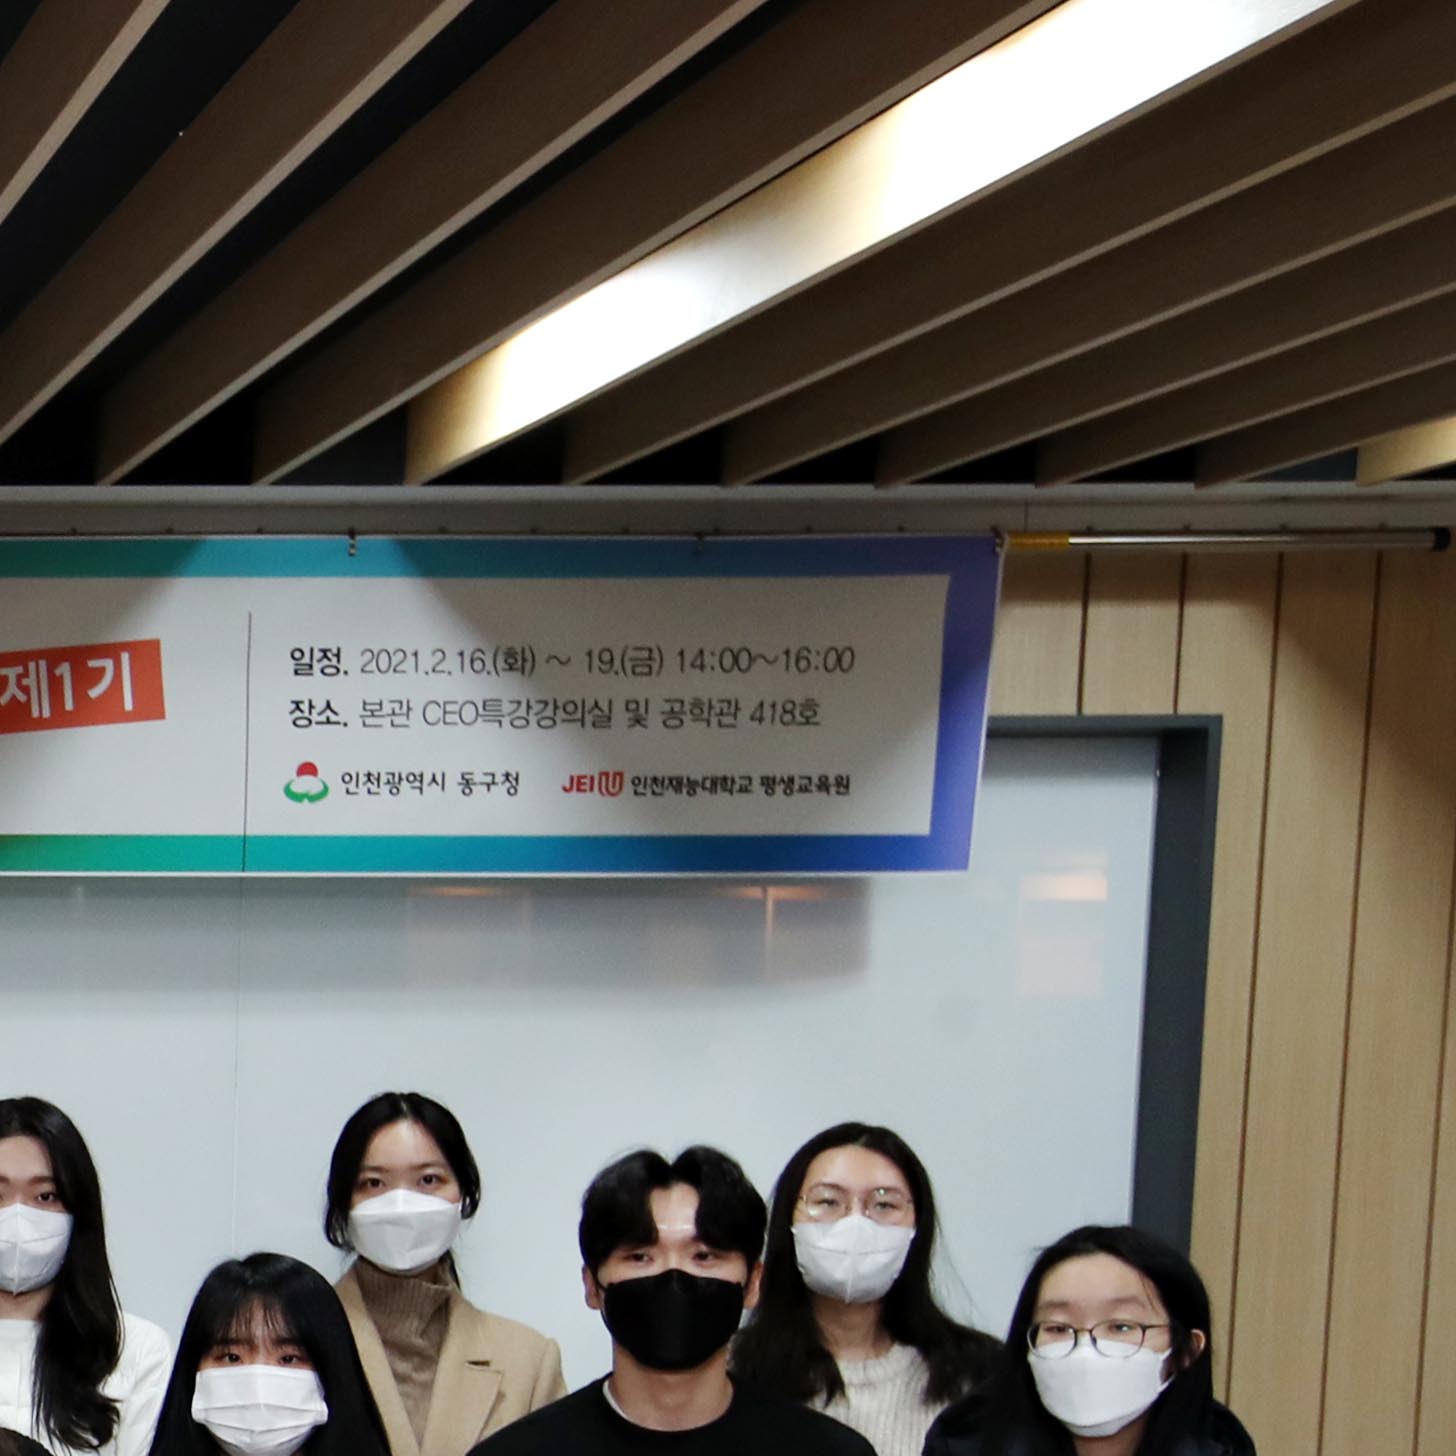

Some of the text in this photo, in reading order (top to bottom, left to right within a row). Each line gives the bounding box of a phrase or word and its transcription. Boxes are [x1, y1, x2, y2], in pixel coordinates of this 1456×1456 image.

[289, 646, 349, 677] 일정.
[288, 698, 821, 729] 장소. 본관 CEO특강강의실 및 공학관 418호
[340, 771, 520, 797] 인천광역시 동구청
[630, 774, 754, 797] 인천재능대학교
[759, 774, 852, 798] 평생교육원
